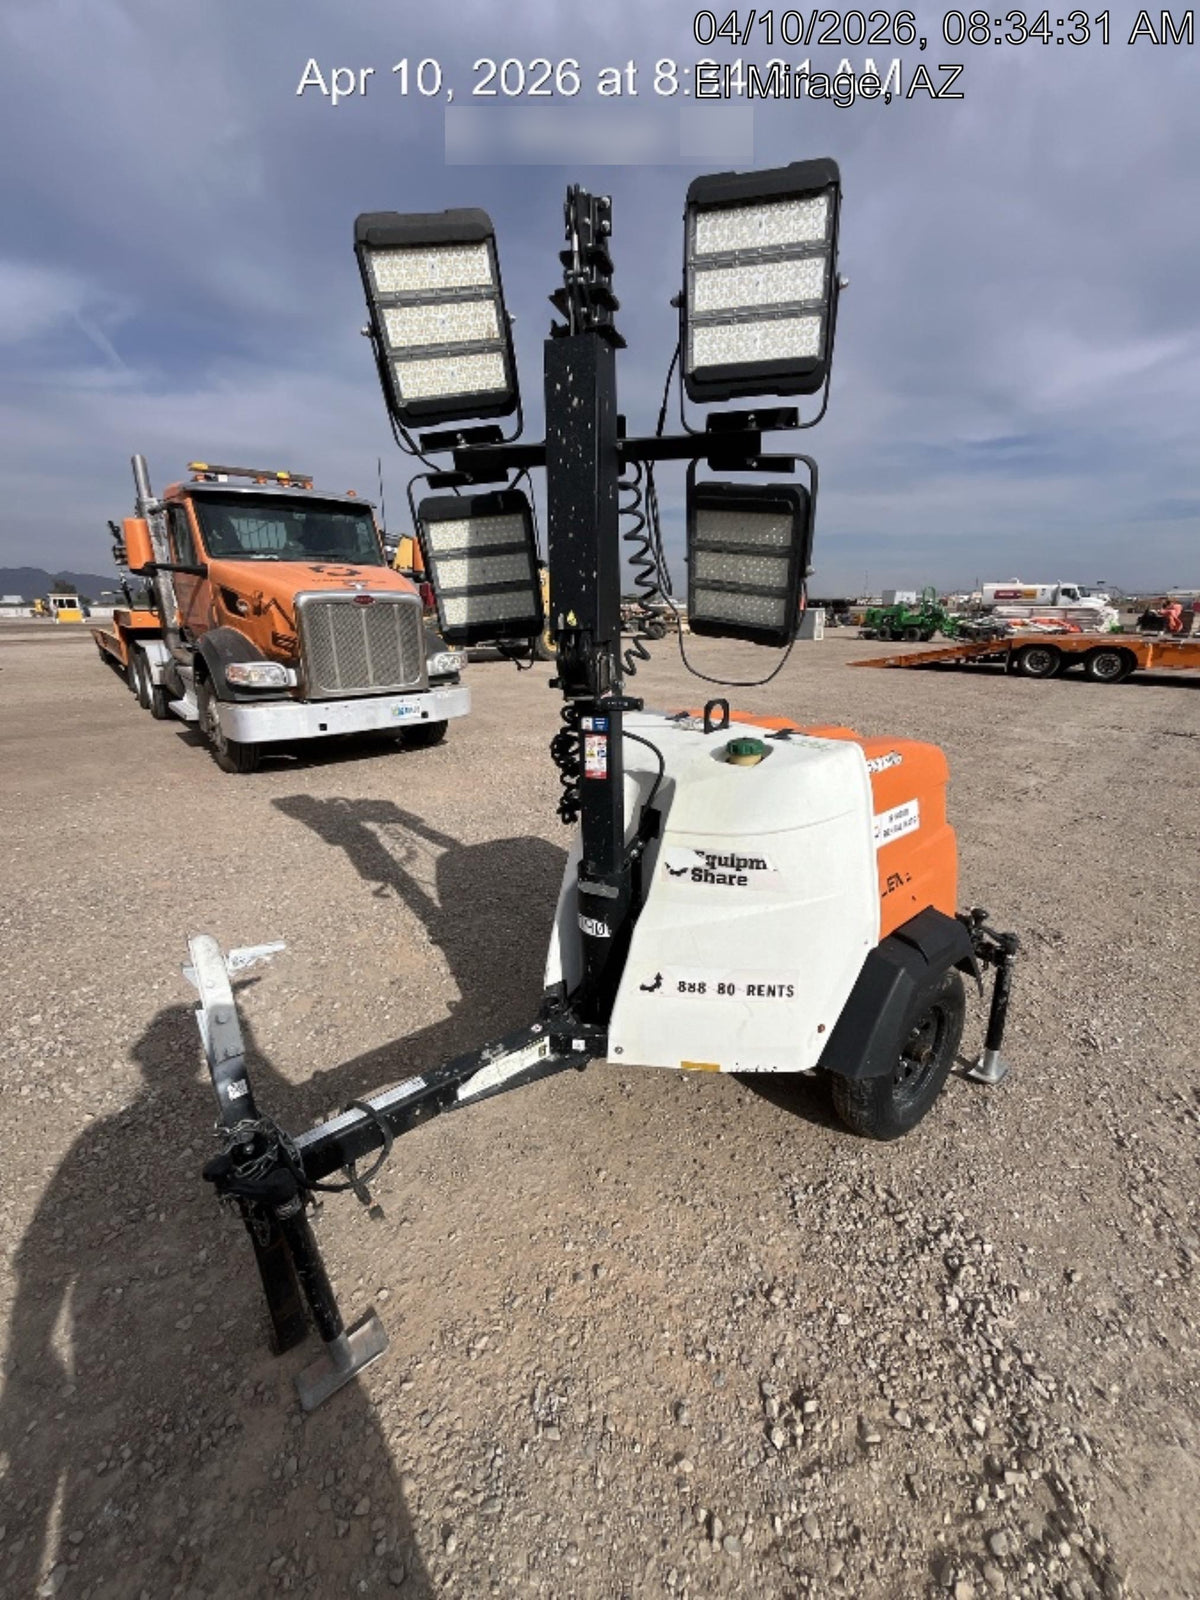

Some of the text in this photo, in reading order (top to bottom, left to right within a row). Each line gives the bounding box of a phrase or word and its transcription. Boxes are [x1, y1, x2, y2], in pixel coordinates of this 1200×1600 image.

[691, 867, 748, 886] Share
[677, 980, 795, 998] 888 80 RENTS
